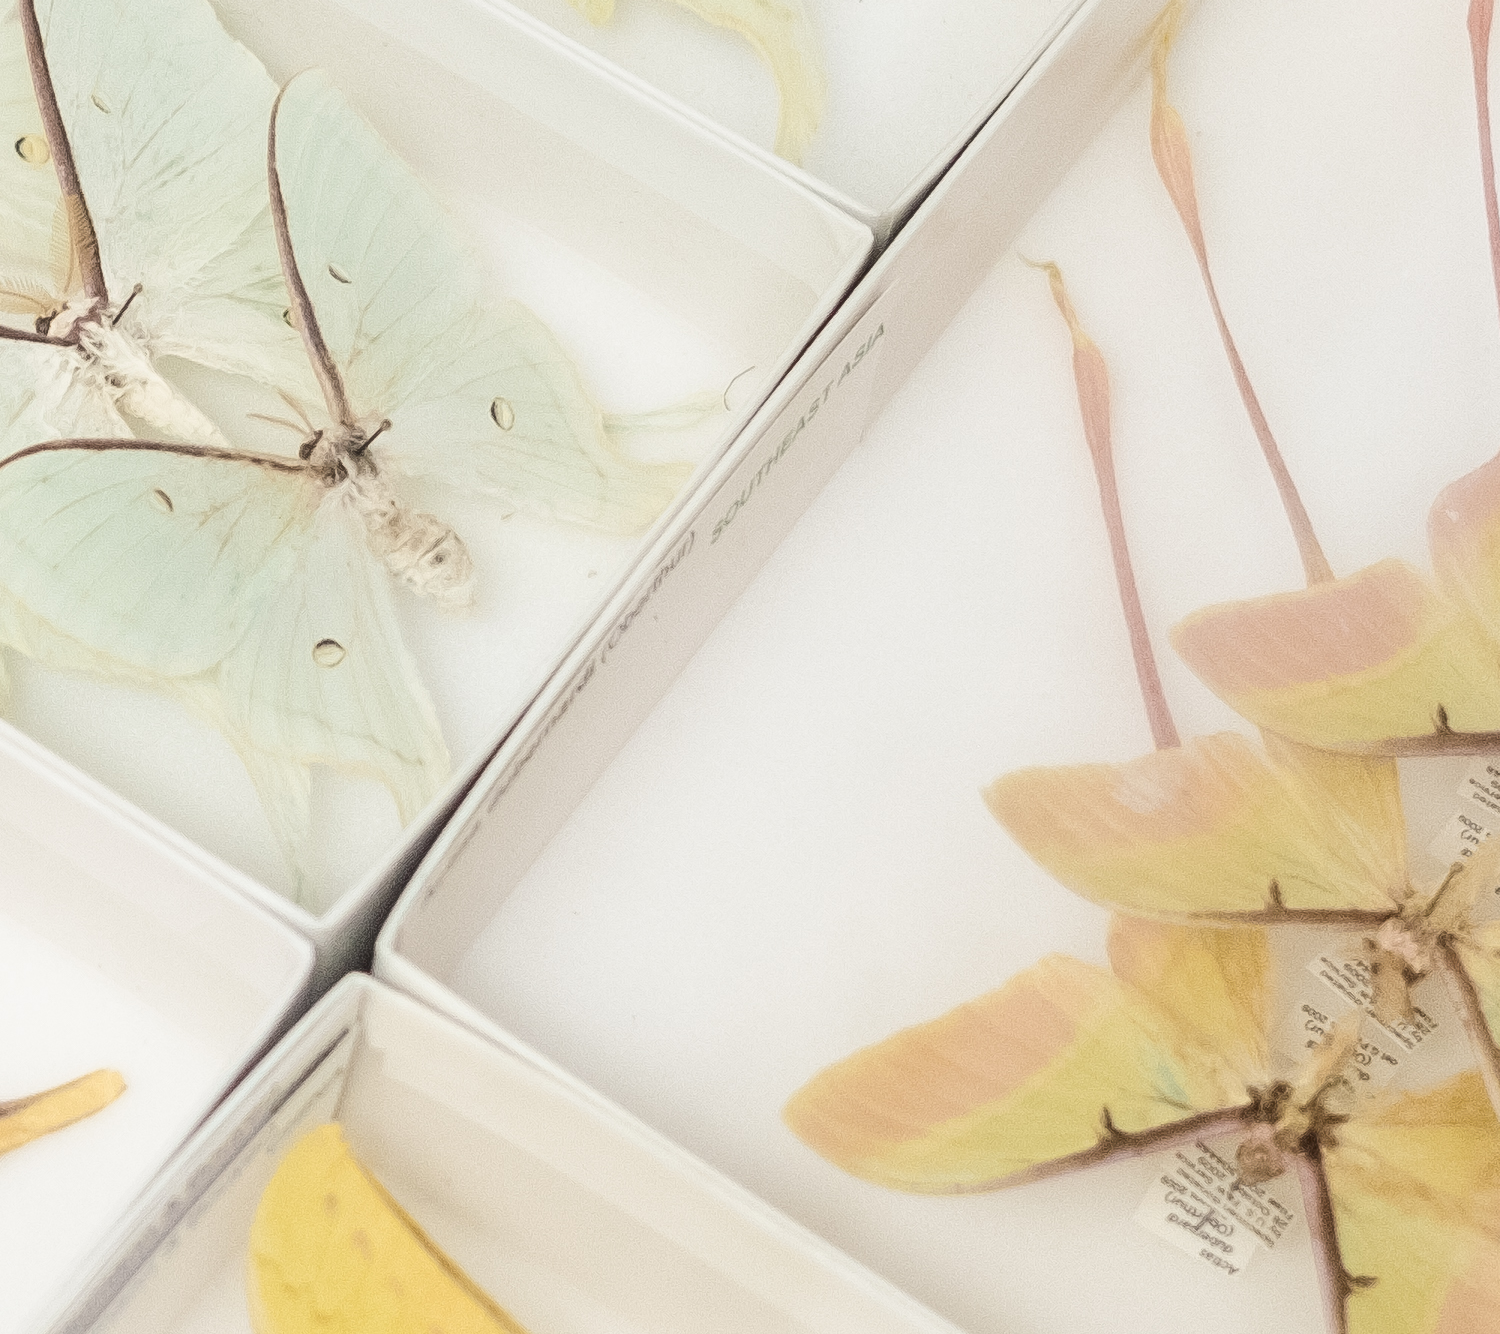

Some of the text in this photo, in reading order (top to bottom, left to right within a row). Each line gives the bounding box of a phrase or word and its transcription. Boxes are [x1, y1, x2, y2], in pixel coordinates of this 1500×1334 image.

[710, 322, 885, 545] SOUTHEAST ASIA
[1199, 1248, 1237, 1276] Actias
